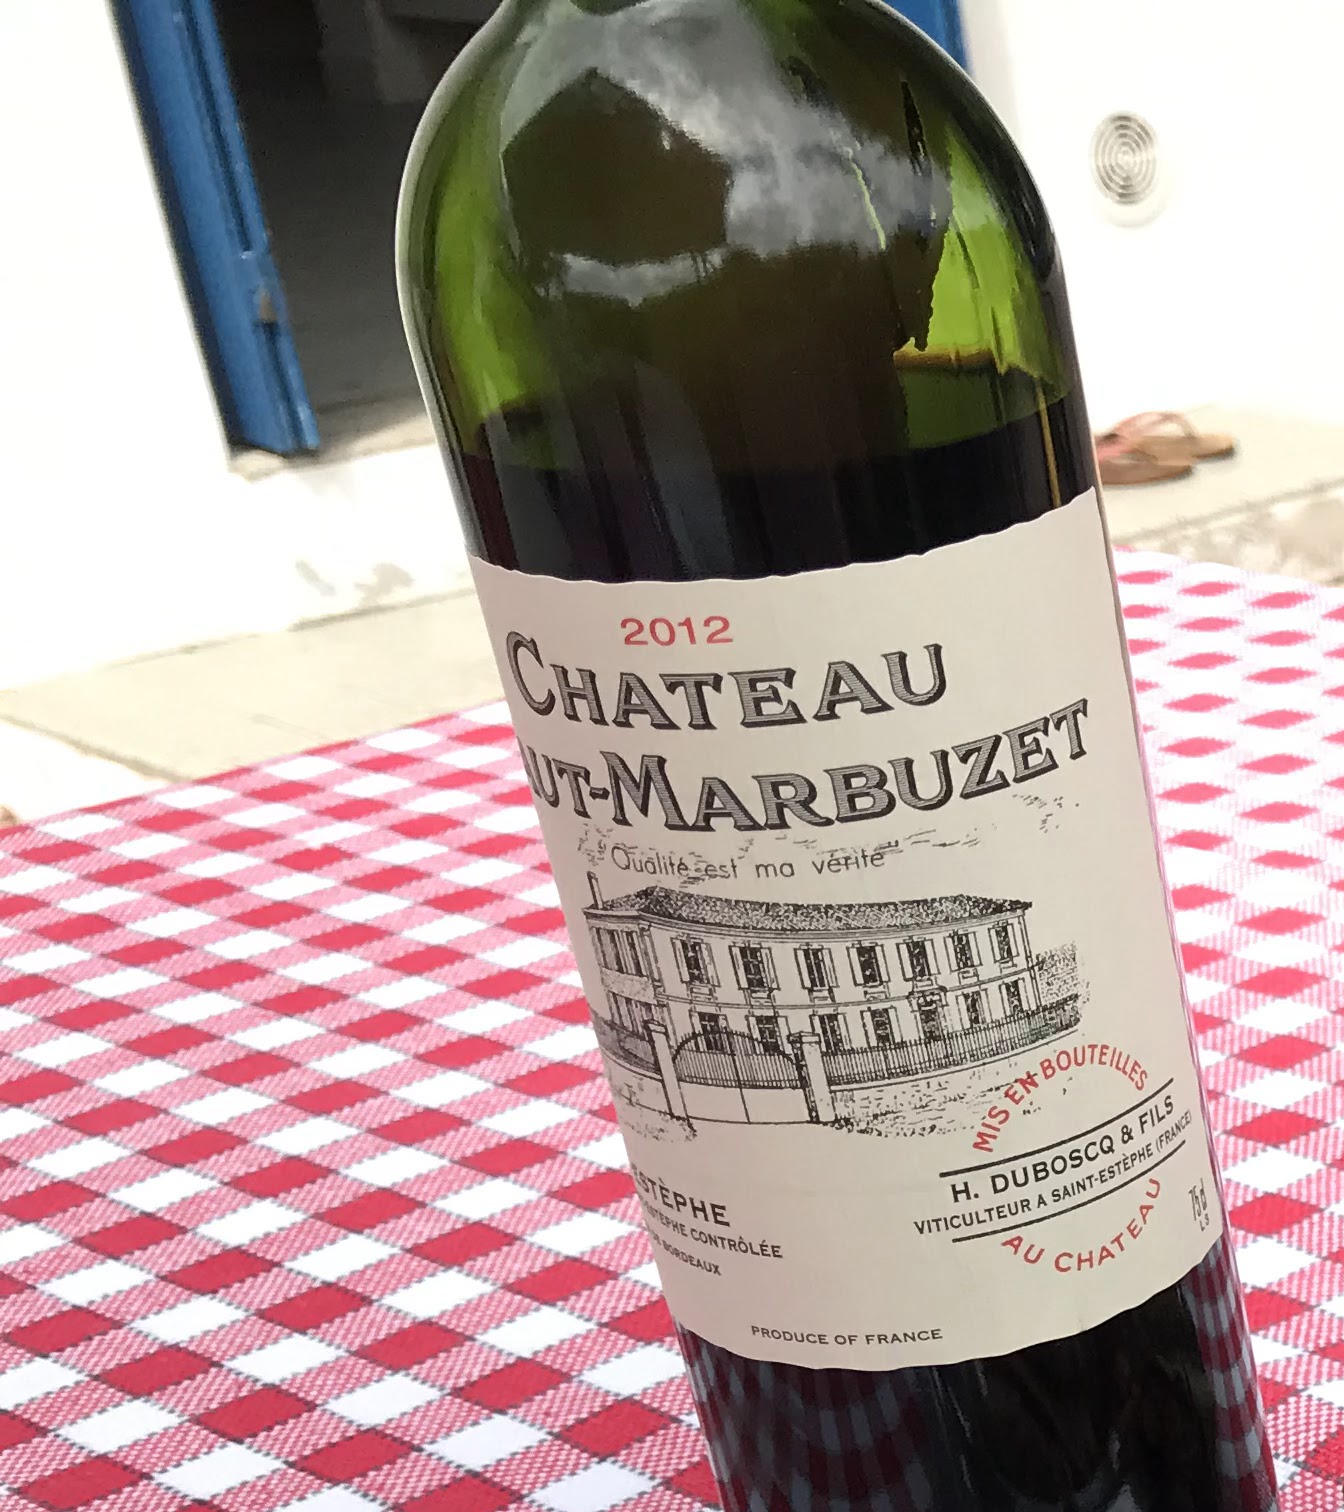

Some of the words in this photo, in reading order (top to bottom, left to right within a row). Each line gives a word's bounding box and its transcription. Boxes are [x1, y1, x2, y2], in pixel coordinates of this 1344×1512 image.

[620, 615, 734, 646] 2012
[506, 631, 947, 730] CHATEAU
[611, 846, 689, 877] Qualité
[705, 856, 739, 879] est
[756, 861, 795, 878] ma
[972, 1105, 1010, 1152] MIS
[1004, 1071, 1039, 1105] EN
[1040, 1044, 1148, 1091] BOUTEILLES
[913, 1198, 1032, 1234] VITICULTEUR
[1051, 1142, 1154, 1203] SAINT-ESTÈPHE
[1156, 1109, 1192, 1153] (FRANCE)
[951, 1181, 979, 1203] H.
[991, 1135, 1115, 1194] DUBOSCQ
[1121, 1125, 1134, 1144] &
[1138, 1095, 1174, 1134] FILS
[662, 1239, 722, 1276] BORDEAUX
[690, 1228, 783, 1259] CONTRÔLÉE
[1001, 1235, 1045, 1264] AU
[1054, 1178, 1161, 1272] CHATEAU
[751, 1325, 829, 1345] PRODUCE
[834, 1334, 858, 1345] OF
[865, 1328, 943, 1345] FRANCE
